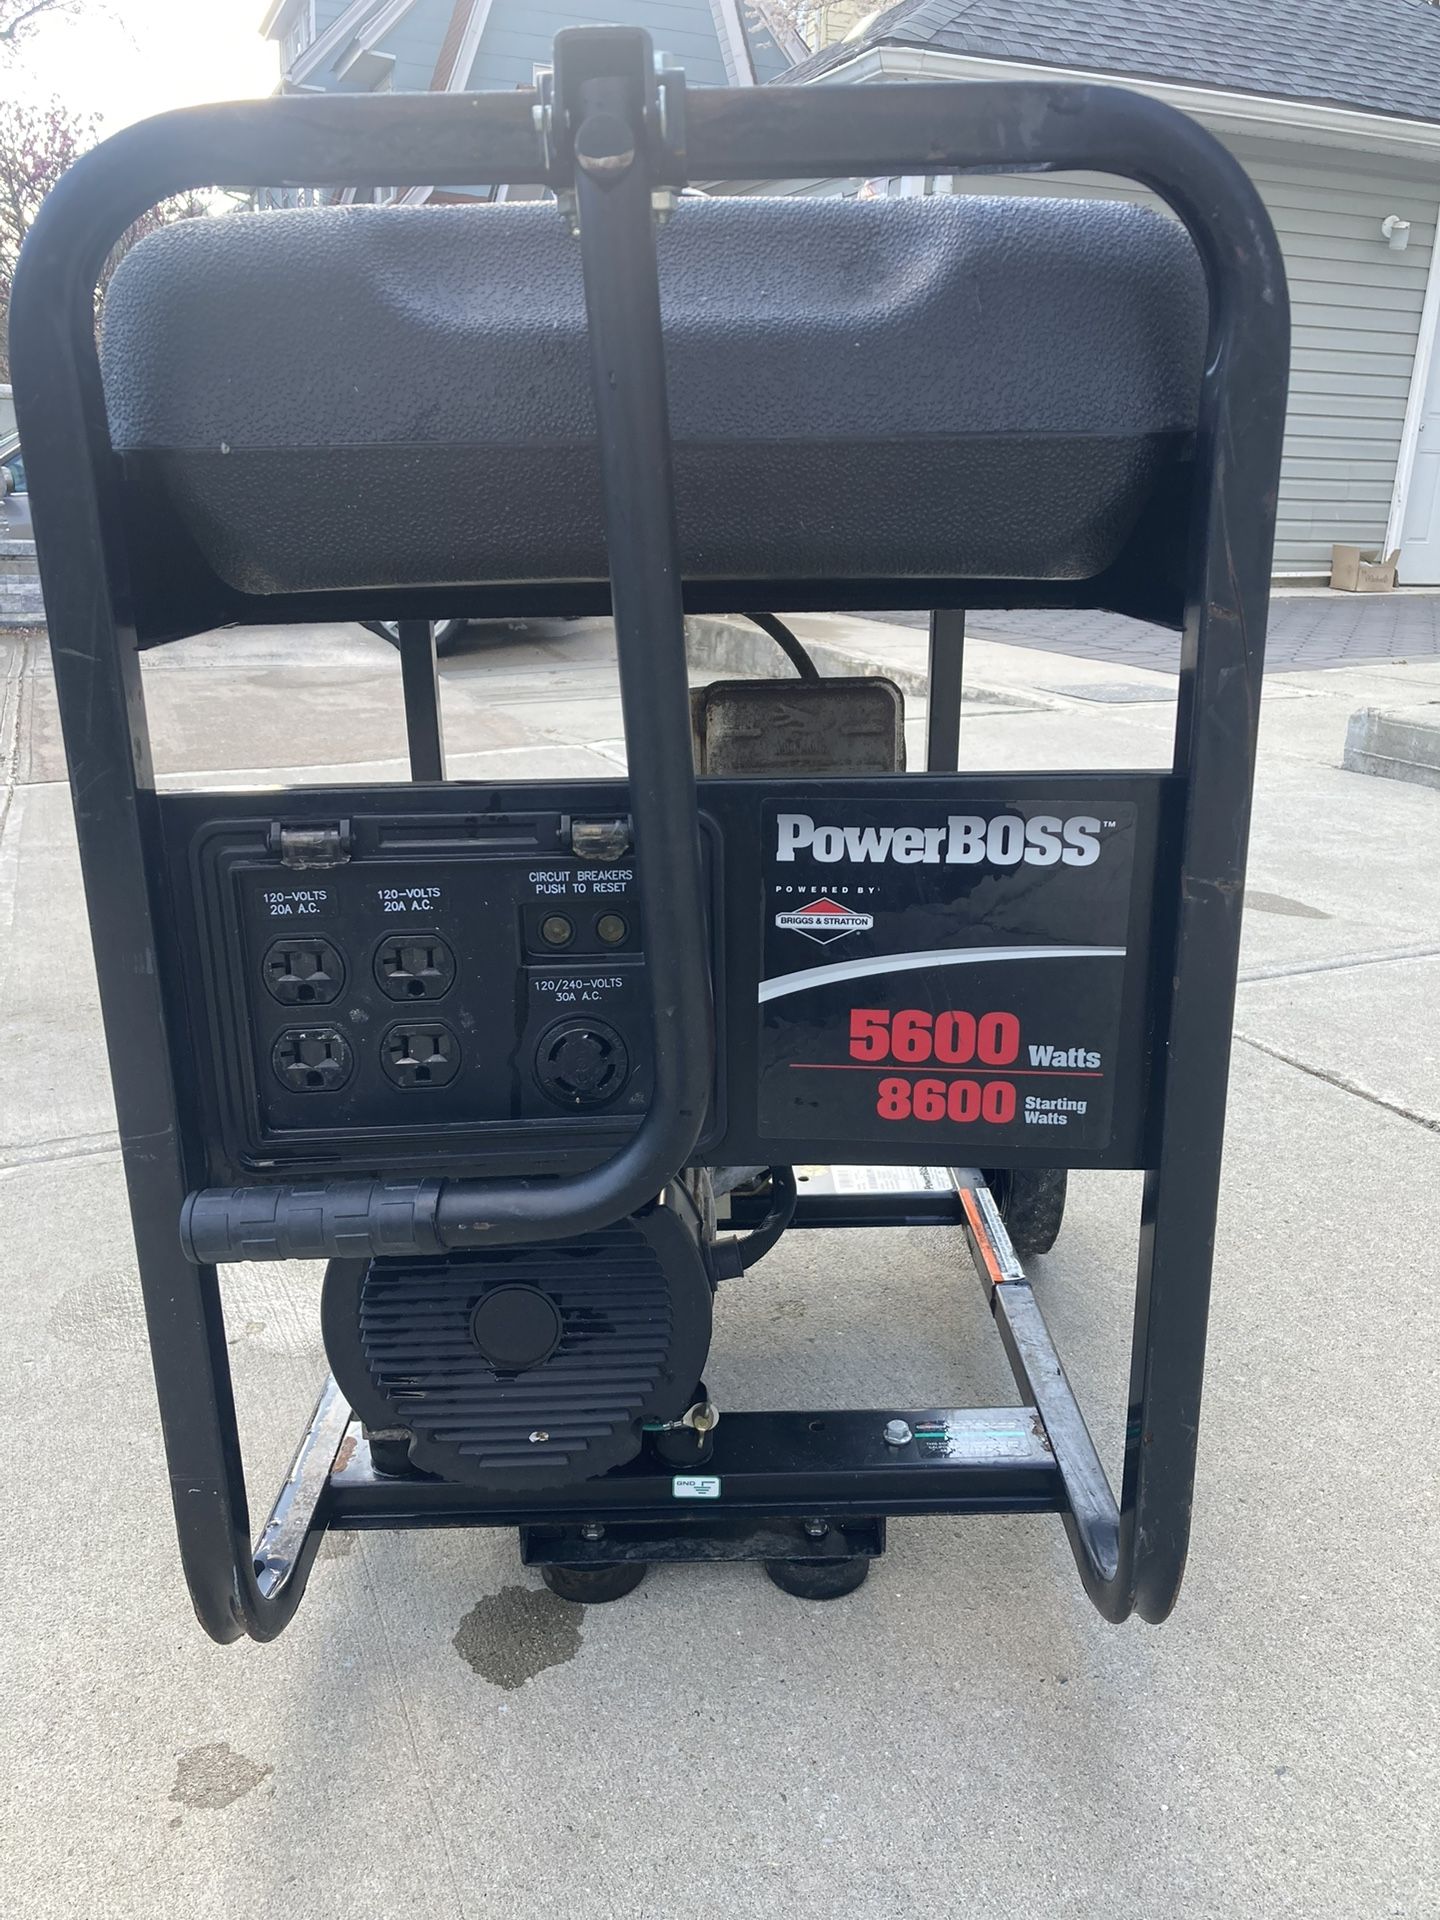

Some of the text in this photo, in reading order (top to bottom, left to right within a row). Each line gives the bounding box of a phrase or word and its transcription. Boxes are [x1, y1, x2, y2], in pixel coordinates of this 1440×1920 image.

[775, 813, 1101, 867] PowerBOSS
[528, 869, 633, 883] CIRCUIT BREAKERS
[377, 887, 441, 900] 120-VOLTS
[535, 882, 627, 894] PUSH TO RESET
[775, 885, 849, 894] POWERED
[263, 890, 327, 902] 120-VOLTS
[270, 902, 321, 915] 20A A.C.
[384, 900, 434, 912] 20A A.C.
[780, 916, 869, 926] BRIGGS & STRATTON
[535, 977, 623, 992] 120/240-VOLTS
[555, 990, 602, 1002] 30A A.C.
[849, 1008, 1102, 1069] 5600 Watts
[876, 1077, 1088, 1124] 8600 Starting
[1024, 1110, 1068, 1125] Watts
